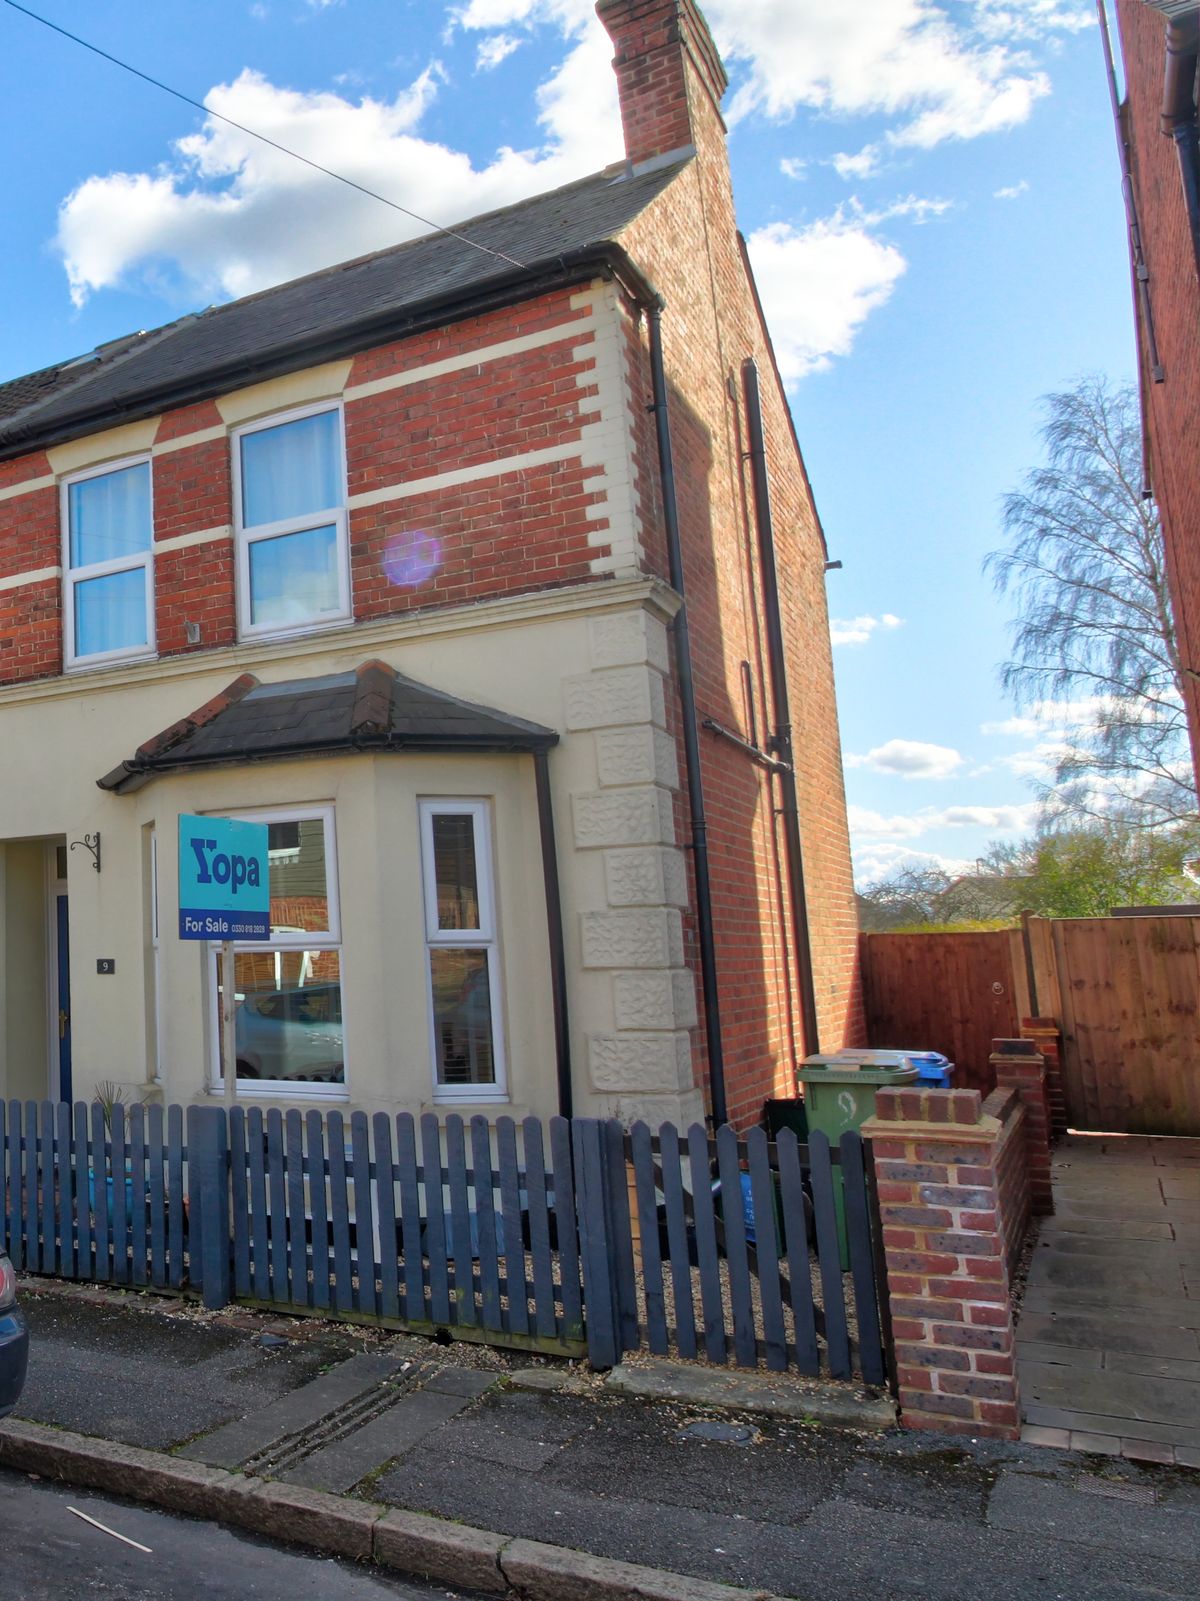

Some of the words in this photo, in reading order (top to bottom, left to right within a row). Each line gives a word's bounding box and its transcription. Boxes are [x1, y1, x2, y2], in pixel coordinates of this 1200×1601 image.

[190, 838, 260, 894] Yopa
[185, 916, 203, 932] For
[205, 917, 229, 933] Sale
[102, 961, 109, 972] 9
